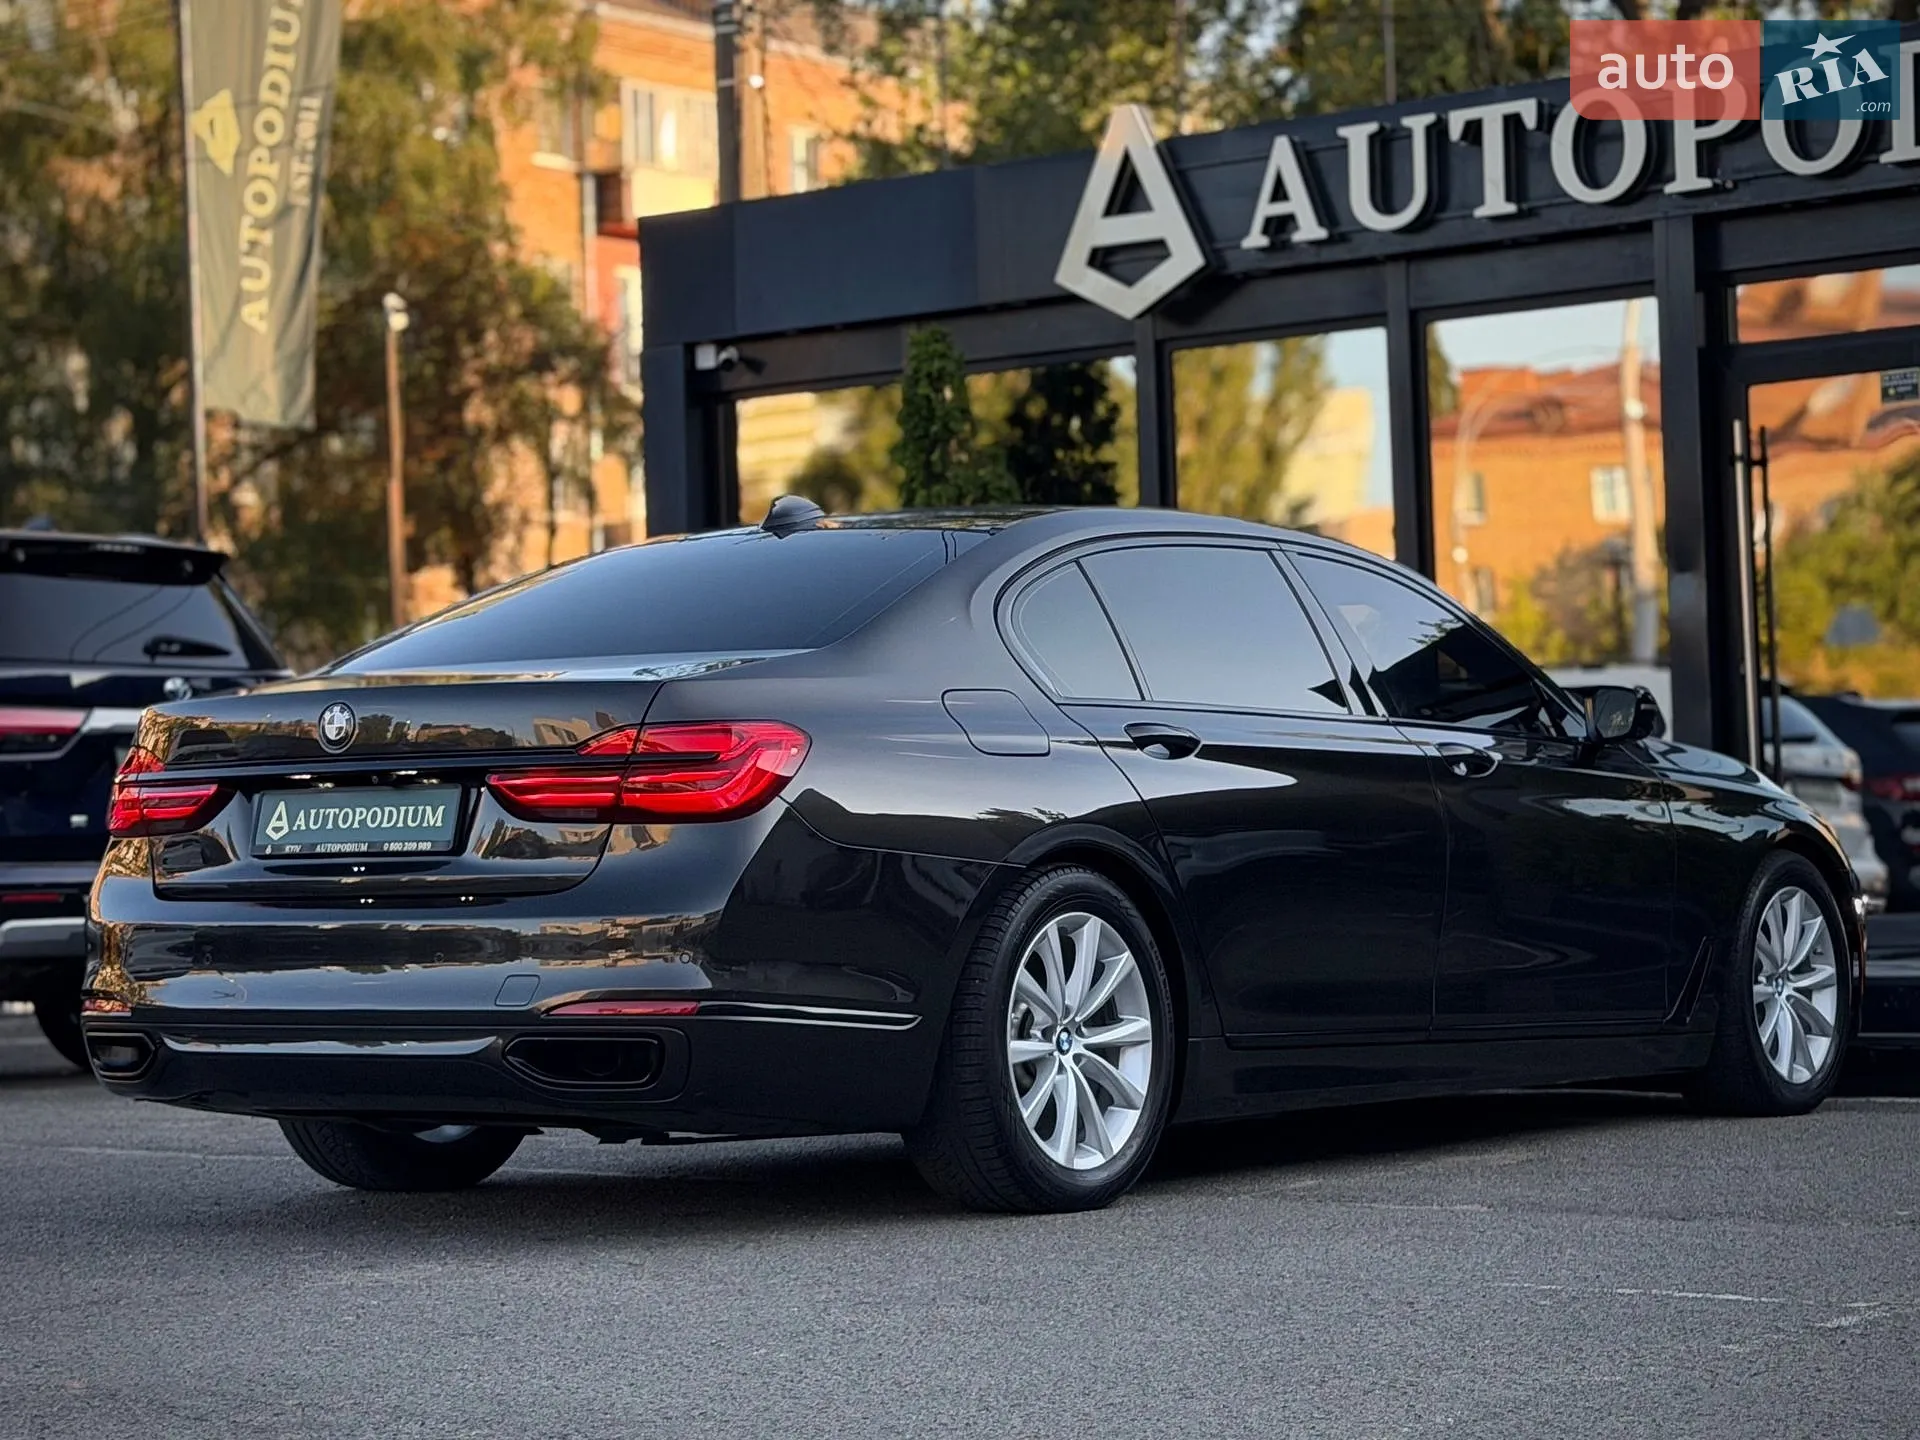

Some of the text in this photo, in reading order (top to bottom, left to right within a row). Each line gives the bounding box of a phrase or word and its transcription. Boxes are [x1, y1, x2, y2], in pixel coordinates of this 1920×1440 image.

[240, 0, 303, 335] AUTOPODIU
[292, 805, 446, 831] AUTOPODIUM
[315, 842, 368, 853] AUTOPODIUM
[383, 842, 389, 851] 0
